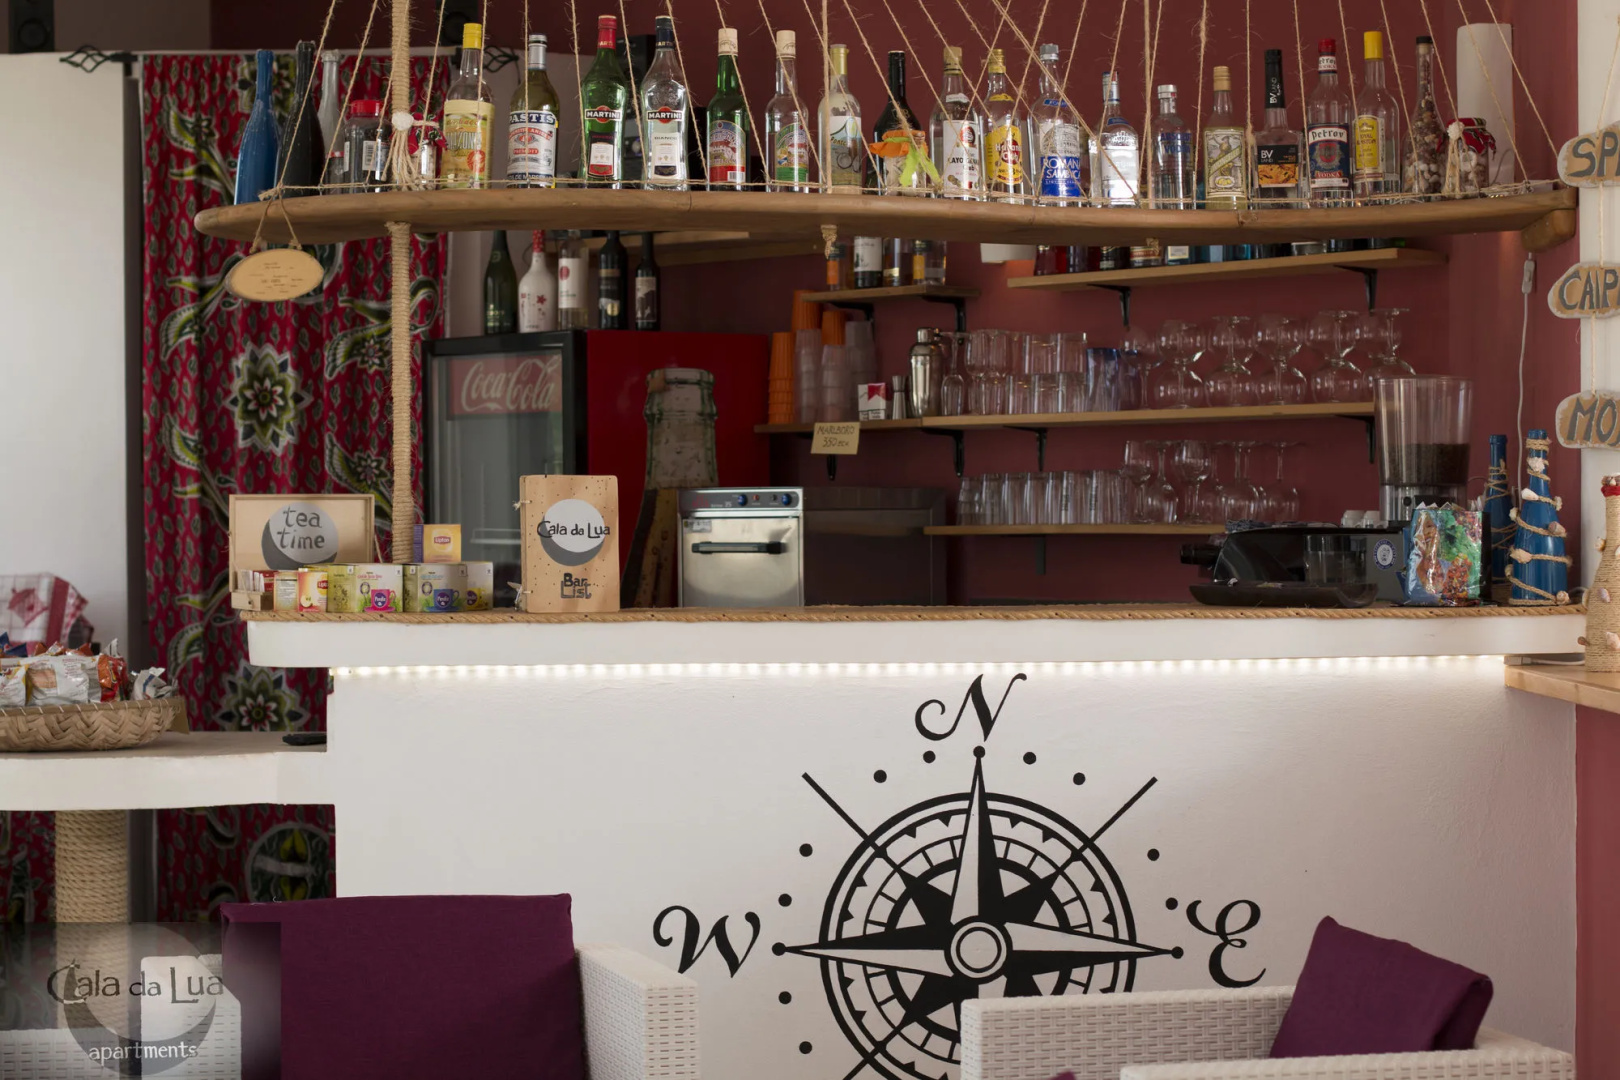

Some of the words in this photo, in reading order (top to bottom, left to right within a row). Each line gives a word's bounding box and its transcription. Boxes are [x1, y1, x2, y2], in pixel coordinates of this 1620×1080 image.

[1269, 92, 1278, 104] BV
[511, 113, 554, 124] ASTIS
[586, 111, 620, 119] MARTINI
[648, 111, 682, 119] MARTINI
[1311, 129, 1344, 140] Petrov
[1261, 149, 1273, 158] BV
[1567, 131, 1620, 177] SP
[1043, 158, 1080, 170] ROMAN
[1558, 268, 1620, 311] CAIP
[282, 506, 322, 529] tea
[536, 520, 567, 539] Cala
[570, 523, 585, 536] da
[587, 521, 611, 539] Lua
[277, 530, 325, 550] time
[563, 572, 588, 587] Bar
[915, 673, 1027, 742] N
[652, 905, 761, 978] W
[1186, 899, 1267, 988] E
